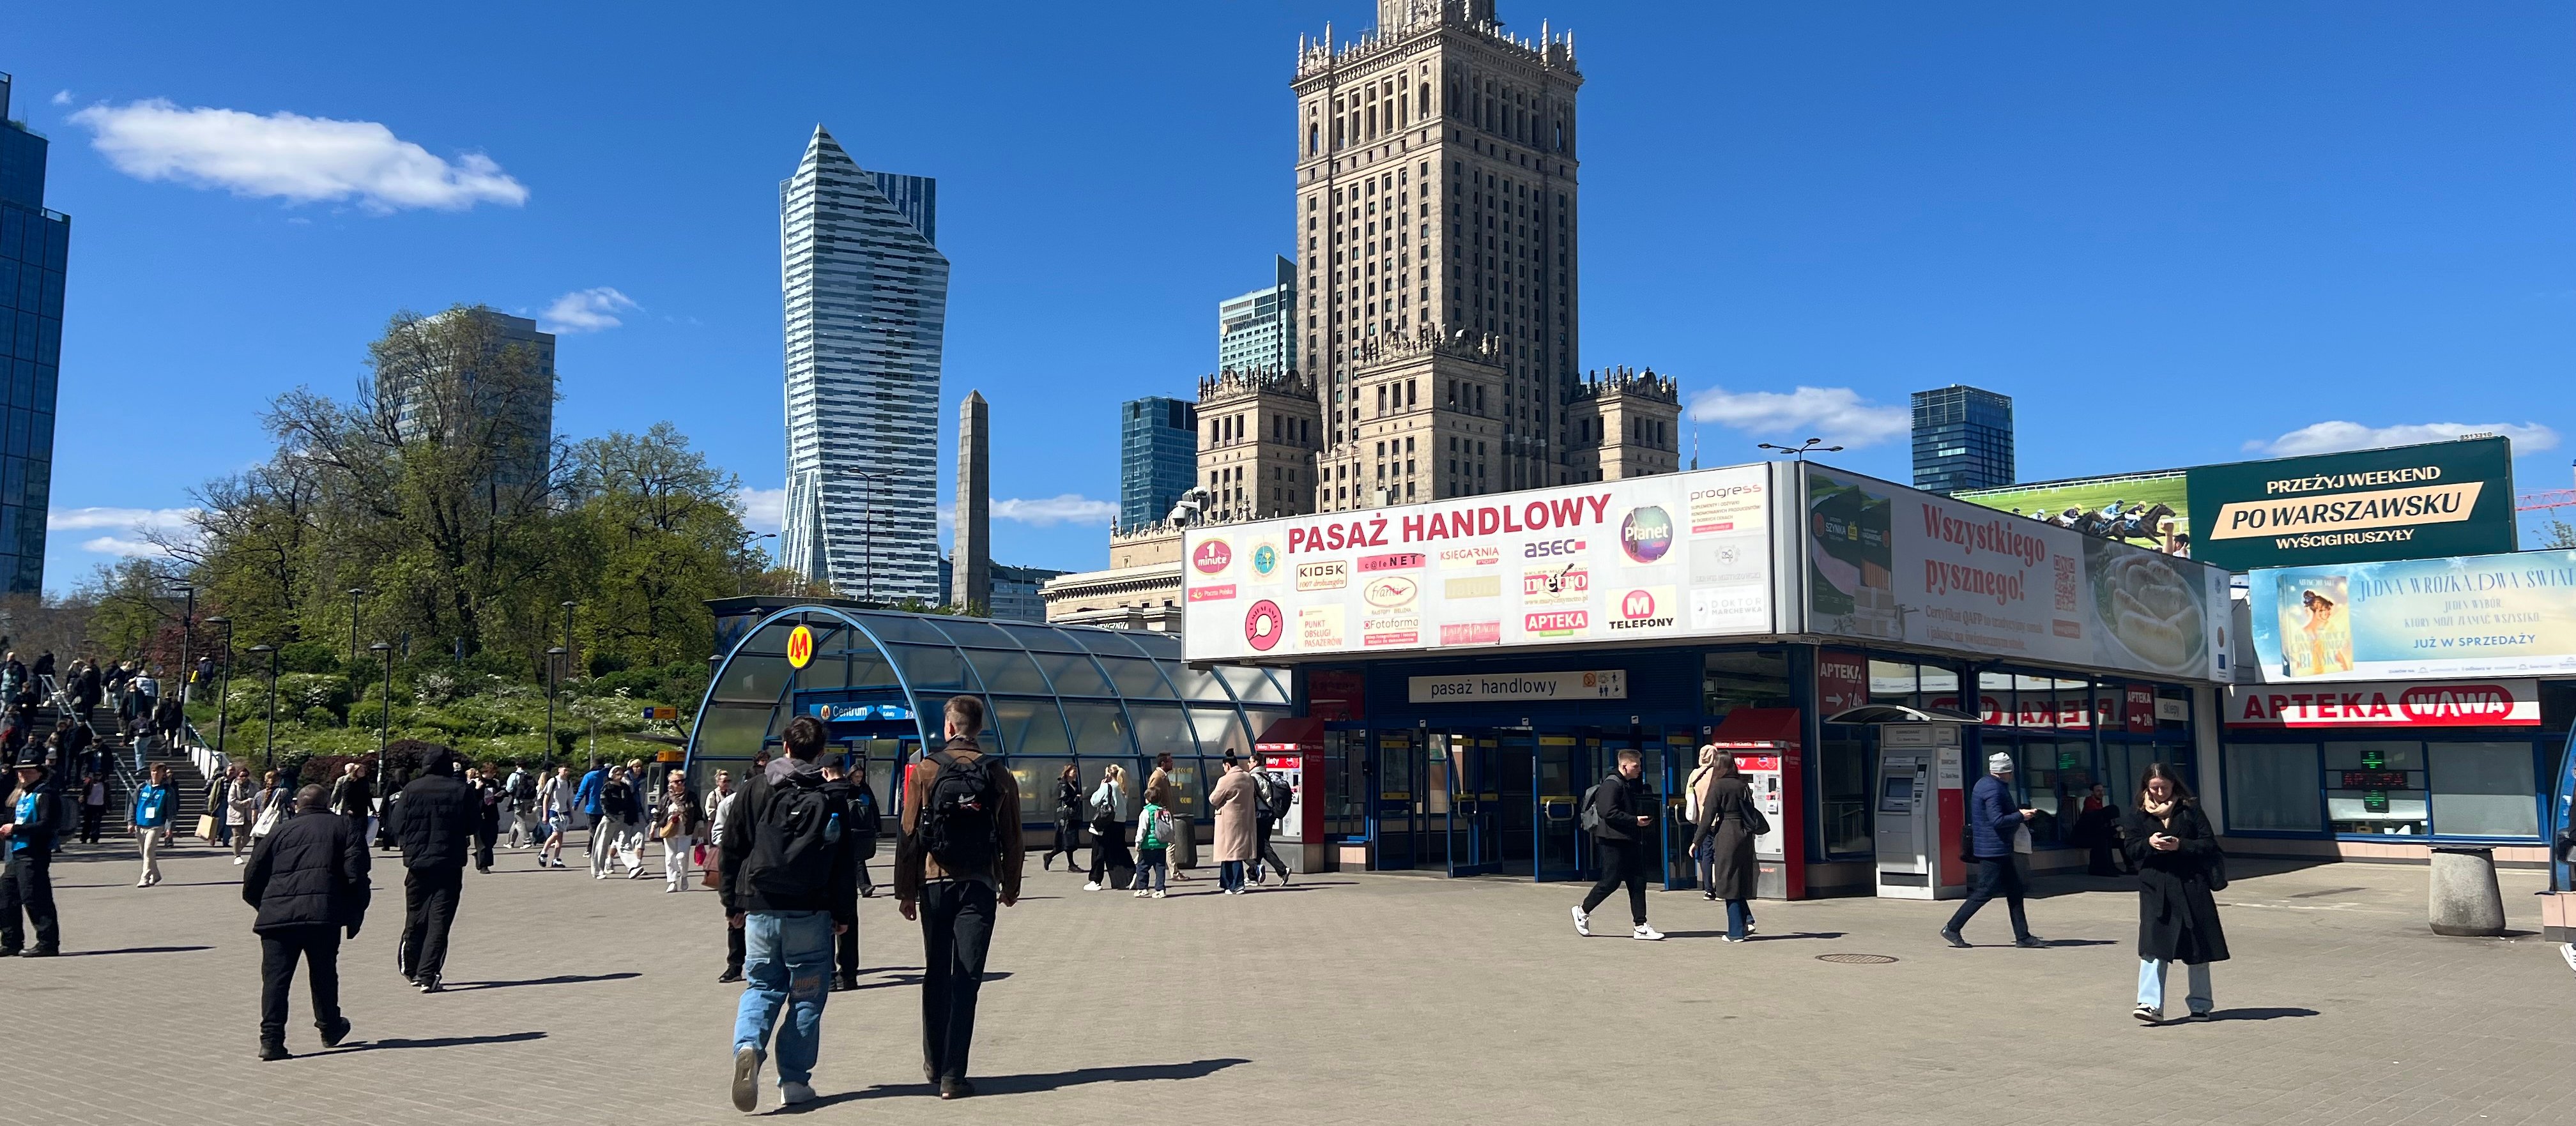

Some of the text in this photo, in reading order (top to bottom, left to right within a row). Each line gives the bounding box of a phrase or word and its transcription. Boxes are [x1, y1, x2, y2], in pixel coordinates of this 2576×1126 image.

[2267, 466, 2441, 494] PRZEŻYJ WEEKEND
[1690, 485, 1761, 501] progress
[2232, 492, 2462, 530] PO WARSZAWSKU
[1289, 494, 1612, 554] PASAŻ HANDLOWY
[1825, 522, 1846, 535] SZYNKA
[1625, 523, 1669, 542] Planet
[1922, 503, 2045, 568] Wszystkiego
[2276, 529, 2414, 550] WYŚCIGI RUSZYŁY
[1206, 542, 1215, 558] 1
[1440, 547, 1499, 561] KSIĘGARNIA
[1198, 556, 1227, 567] minute
[1300, 565, 1344, 577] KIOSK
[1524, 573, 1587, 592] metro
[1925, 559, 2025, 605] pysznego!
[1627, 597, 1650, 615] M
[1305, 620, 1326, 628] PUNKT
[1370, 618, 1418, 629] Fotoforma
[1528, 612, 1586, 630] APTEKA
[1609, 618, 1674, 629] TELEFONY
[1305, 628, 1331, 638] OBSŁUGI
[1305, 635, 1342, 647] PASAŻERÓW
[2413, 633, 2536, 648] JUŻ W SPRZEDAŻY
[790, 633, 808, 660] M
[1820, 663, 1862, 680] APTEKA
[1431, 678, 1557, 699] pasaż handlowy
[2127, 691, 2152, 704] APTEKA
[2243, 690, 2506, 720] APTEKA WAWA
[832, 706, 868, 717] Centrum
